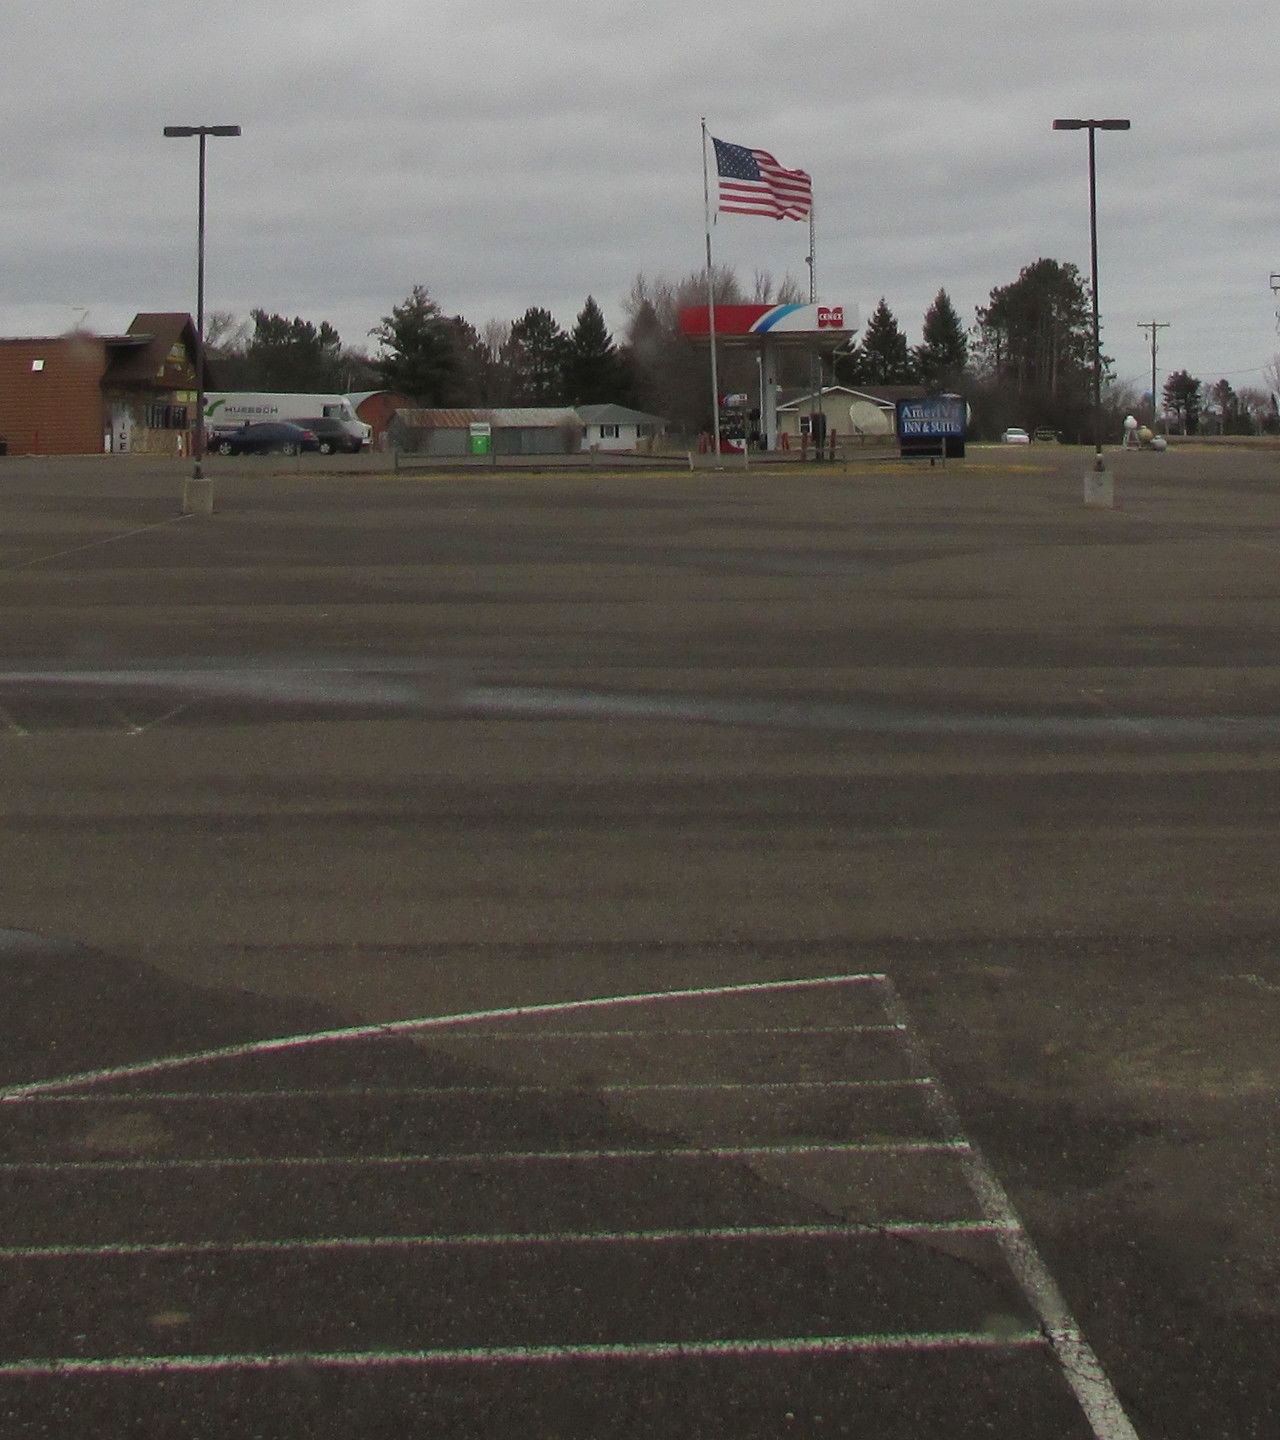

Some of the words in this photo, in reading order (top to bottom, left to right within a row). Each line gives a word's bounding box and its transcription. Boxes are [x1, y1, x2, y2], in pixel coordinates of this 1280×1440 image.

[119, 422, 128, 451] ICE
[904, 421, 921, 433] INN
[922, 422, 930, 433] &
[930, 421, 962, 433] SUITES
